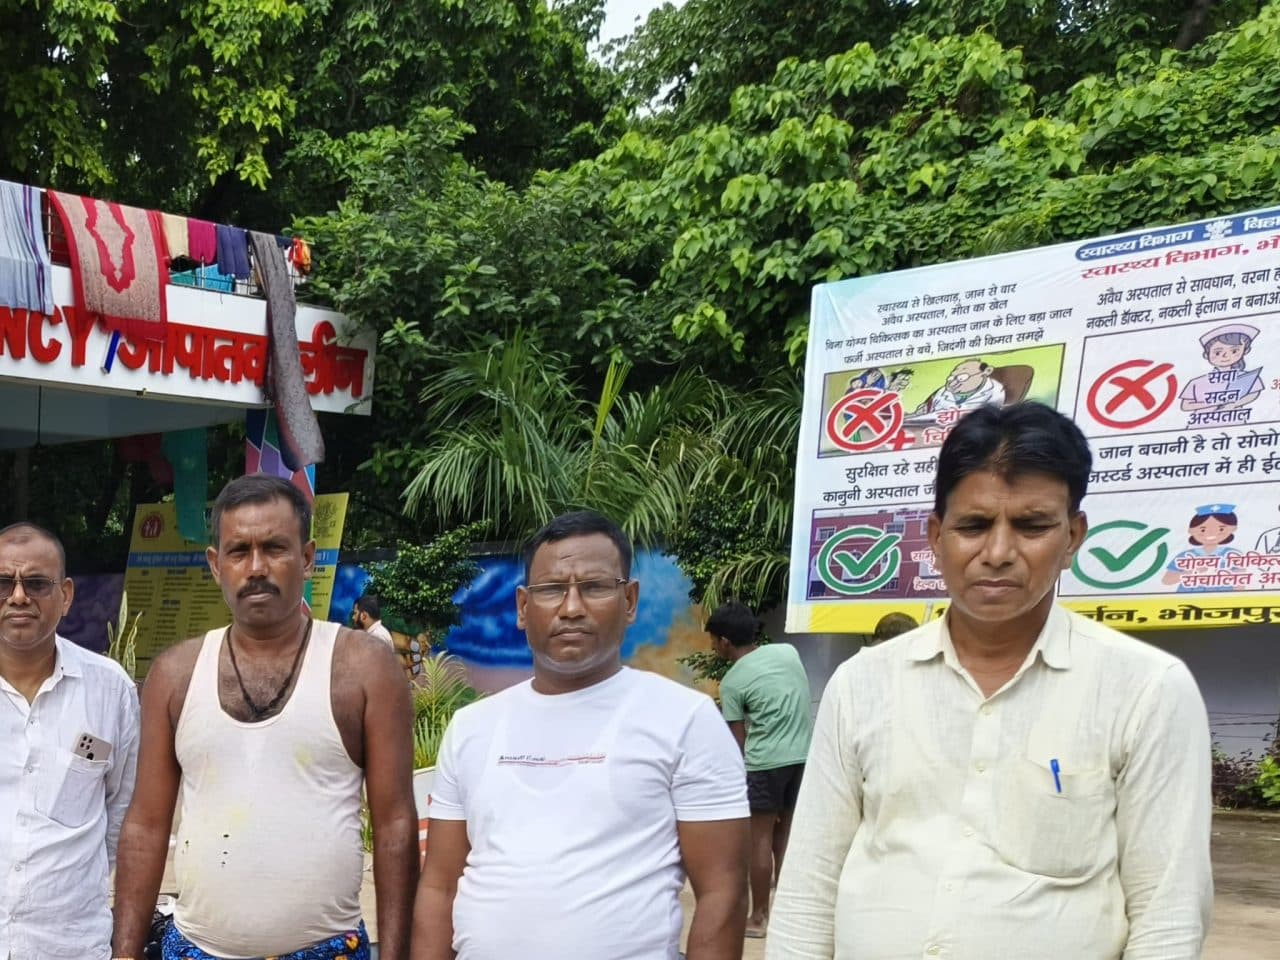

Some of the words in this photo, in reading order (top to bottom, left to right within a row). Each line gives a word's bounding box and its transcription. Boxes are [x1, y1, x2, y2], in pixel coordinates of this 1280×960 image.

[1080, 243, 1136, 259] स्वास्थ्य
[1139, 229, 1195, 249] विभाग
[1080, 257, 1160, 279] स्वास्थ्य
[1165, 243, 1250, 267] विभाग,
[965, 287, 985, 300] जान
[1126, 282, 1172, 302] अस्पताल
[1176, 276, 1187, 294] से
[1241, 268, 1272, 285] वरना
[927, 321, 967, 337] अस्पताल
[1006, 310, 1025, 326] लिए
[1086, 310, 1117, 330] नकली
[1158, 303, 1193, 321] नकली
[1232, 296, 1242, 310] न
[867, 347, 903, 361] अस्पताल
[1208, 368, 1236, 384] सेवा
[1204, 389, 1240, 404] सदन
[1188, 407, 1252, 426] अस्पताल
[1098, 444, 1134, 460] जान
[1138, 436, 1189, 456] बचानी
[1193, 434, 1207, 453] है
[1211, 432, 1232, 451] तो
[845, 461, 889, 483] सुरक्षित
[893, 458, 910, 476] रहे
[1136, 462, 1210, 481] अस्पताल
[1215, 456, 1232, 474] में
[1237, 455, 1256, 472] ही
[865, 484, 919, 500] अस्पताल
[1176, 551, 1221, 570] योग्य
[1181, 569, 1251, 588] संचालित
